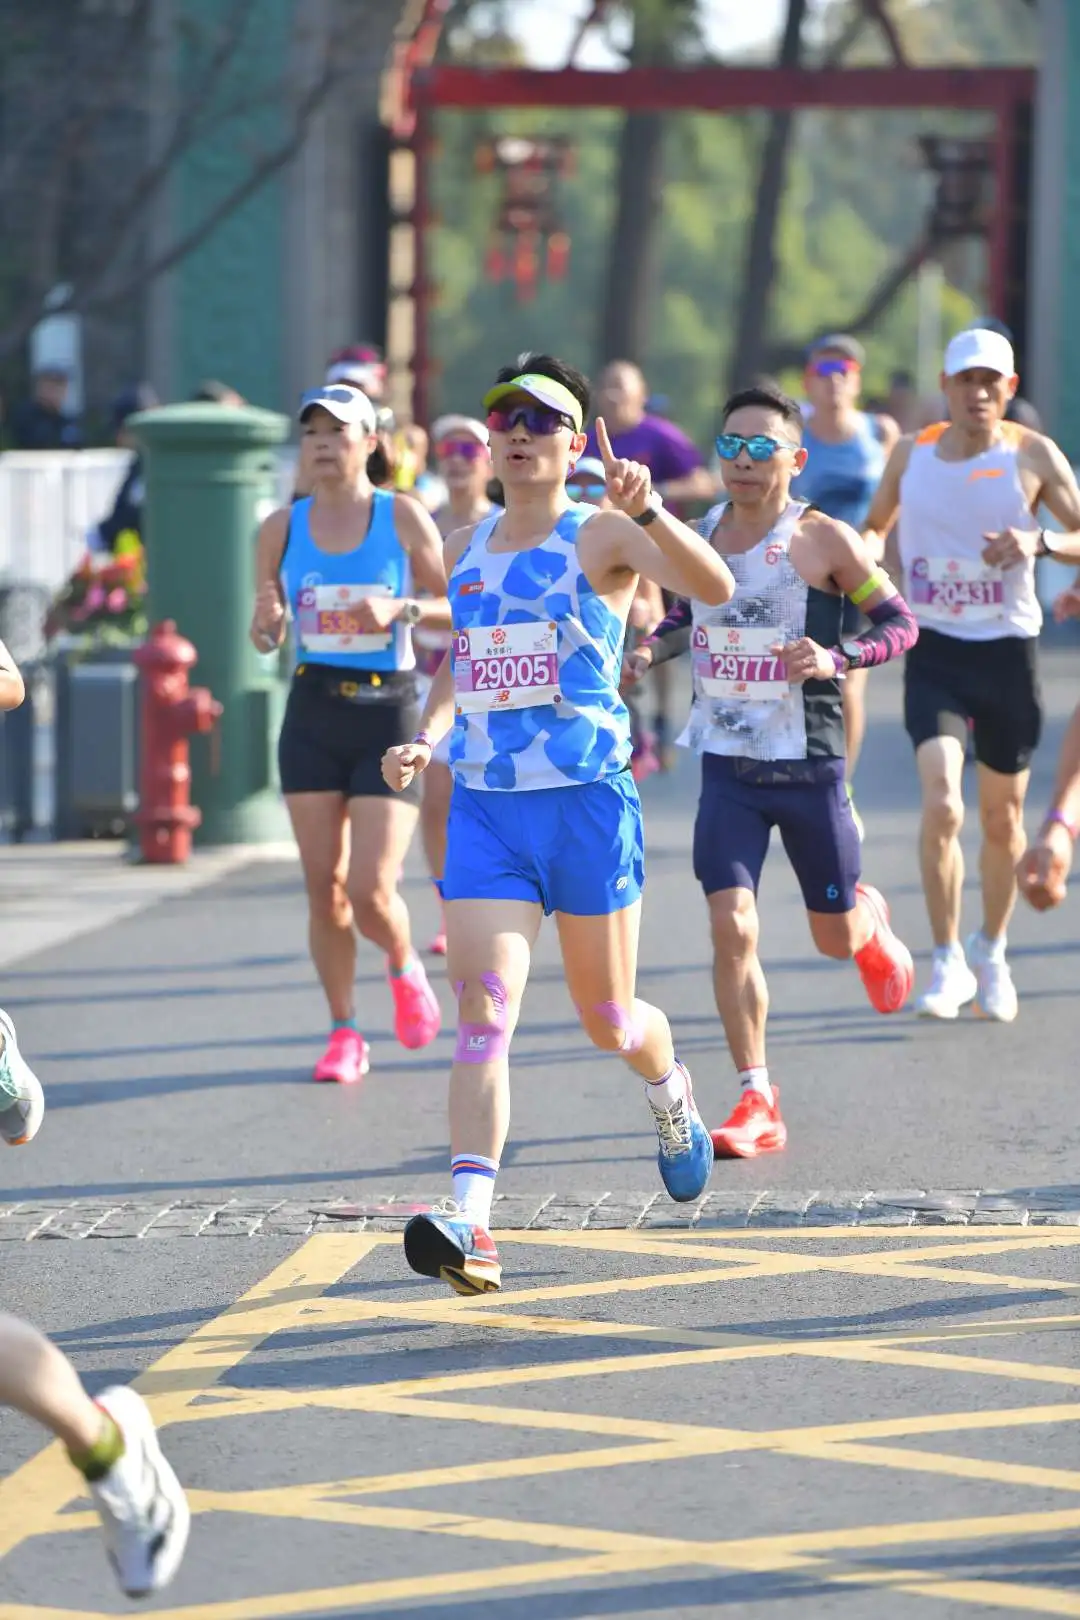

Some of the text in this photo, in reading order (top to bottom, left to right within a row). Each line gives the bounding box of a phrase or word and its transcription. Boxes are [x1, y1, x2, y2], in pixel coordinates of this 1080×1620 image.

[932, 582, 994, 605] 20431
[459, 635, 469, 653] D
[698, 631, 707, 646] D
[474, 656, 550, 690] 29005
[714, 655, 778, 681] 29777
